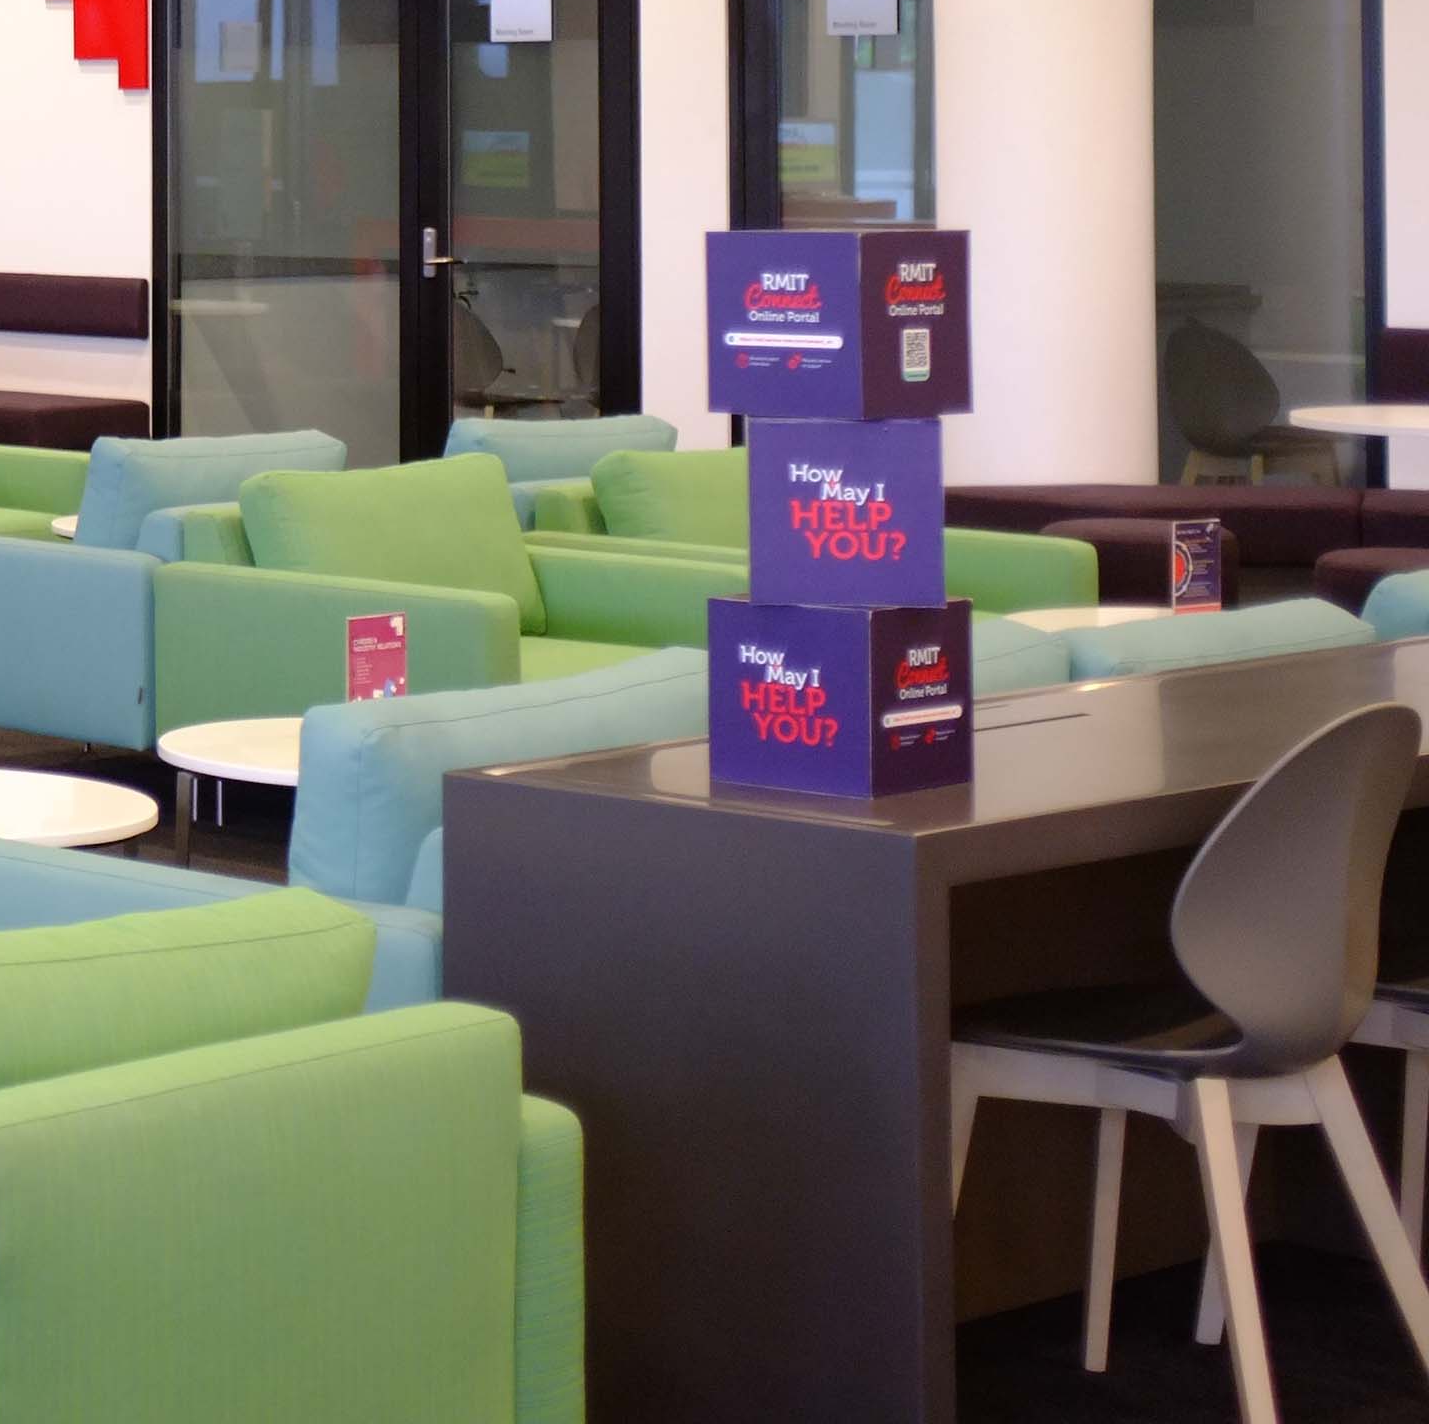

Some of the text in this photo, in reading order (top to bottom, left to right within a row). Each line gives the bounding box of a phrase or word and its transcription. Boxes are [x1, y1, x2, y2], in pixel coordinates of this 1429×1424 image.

[761, 273, 809, 291] RMIT
[899, 263, 937, 282] RMIT
[748, 310, 820, 323] Online Portal
[888, 303, 944, 316] Online Portal
[789, 463, 843, 483] How
[820, 482, 885, 507] May I
[790, 498, 893, 531] HELP
[804, 530, 908, 561] YOU?
[740, 644, 785, 665] How
[908, 646, 942, 667] RMIT
[766, 665, 820, 691] May I
[741, 681, 826, 716] HELP
[899, 683, 948, 700] Online Portal
[753, 712, 839, 748] YOU?
